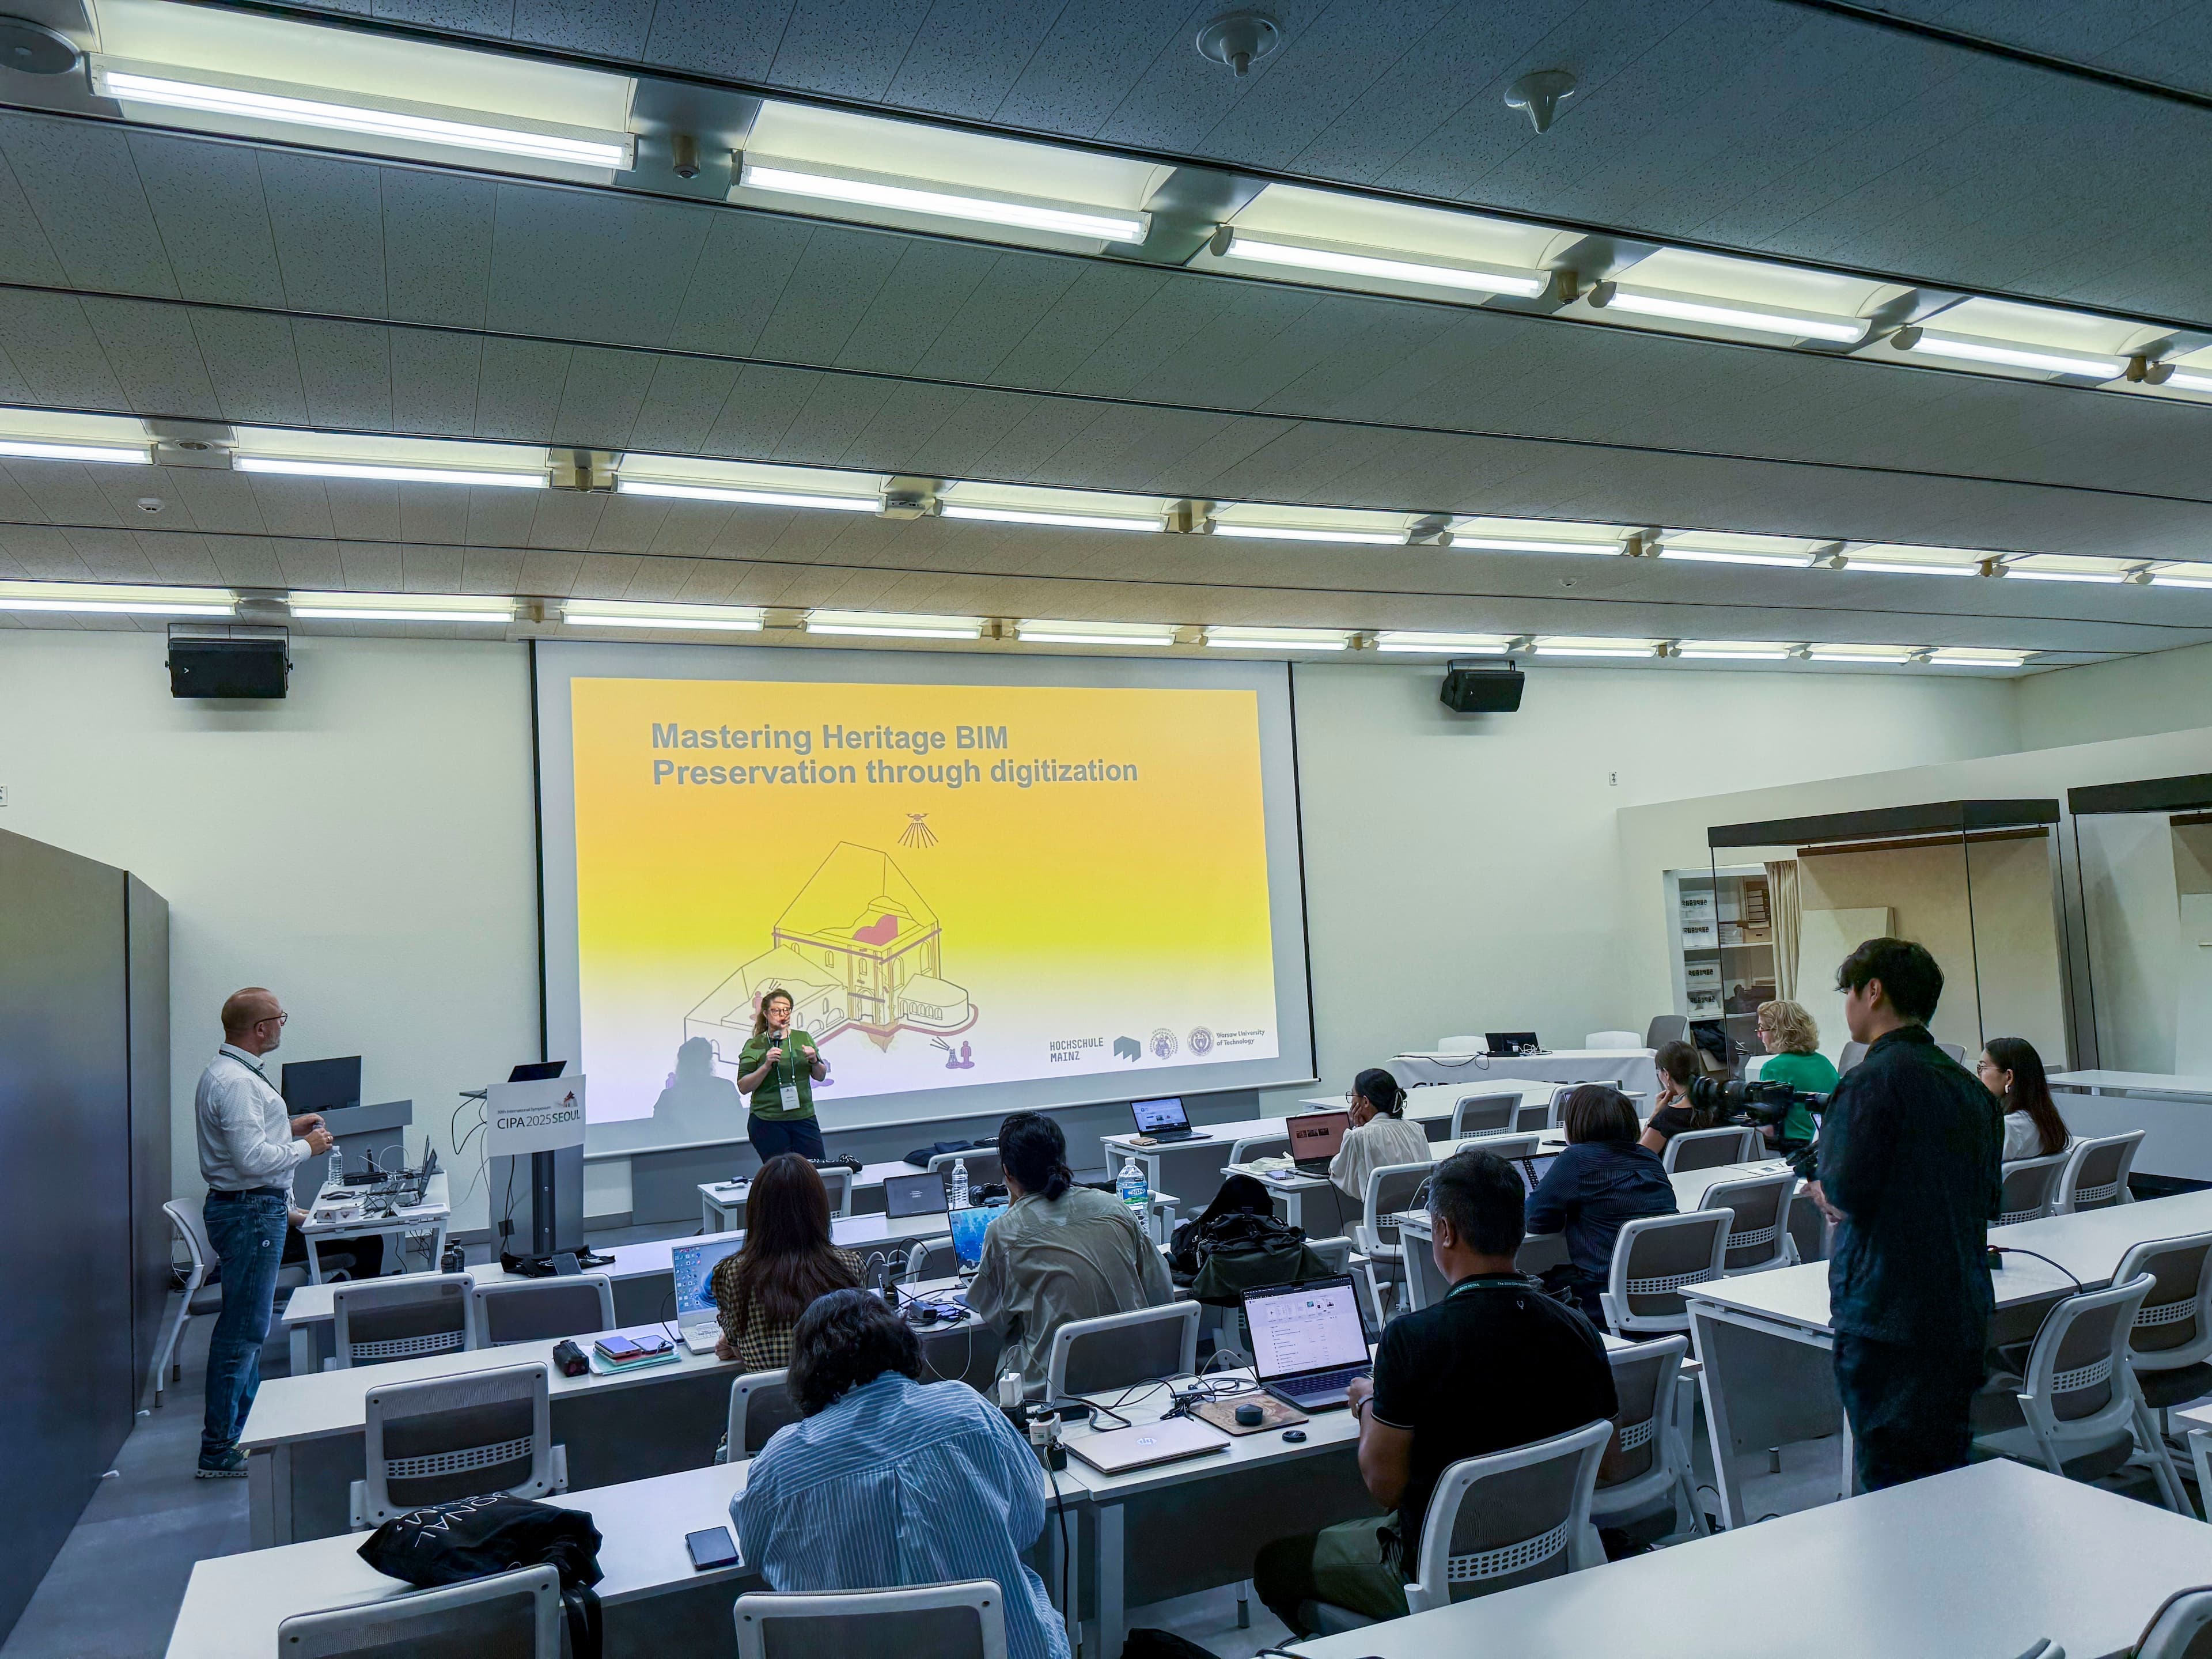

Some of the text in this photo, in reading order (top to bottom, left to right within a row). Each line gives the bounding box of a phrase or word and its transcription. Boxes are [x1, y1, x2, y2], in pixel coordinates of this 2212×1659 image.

[652, 723, 1008, 755] Mastering Heritage BIM
[653, 758, 1138, 789] Preservation through digitization
[1050, 1037, 1104, 1051] HOCHSCHULE
[1050, 1051, 1080, 1062] MAINZ
[497, 1109, 581, 1129] CIPA 2025 SEOUL
